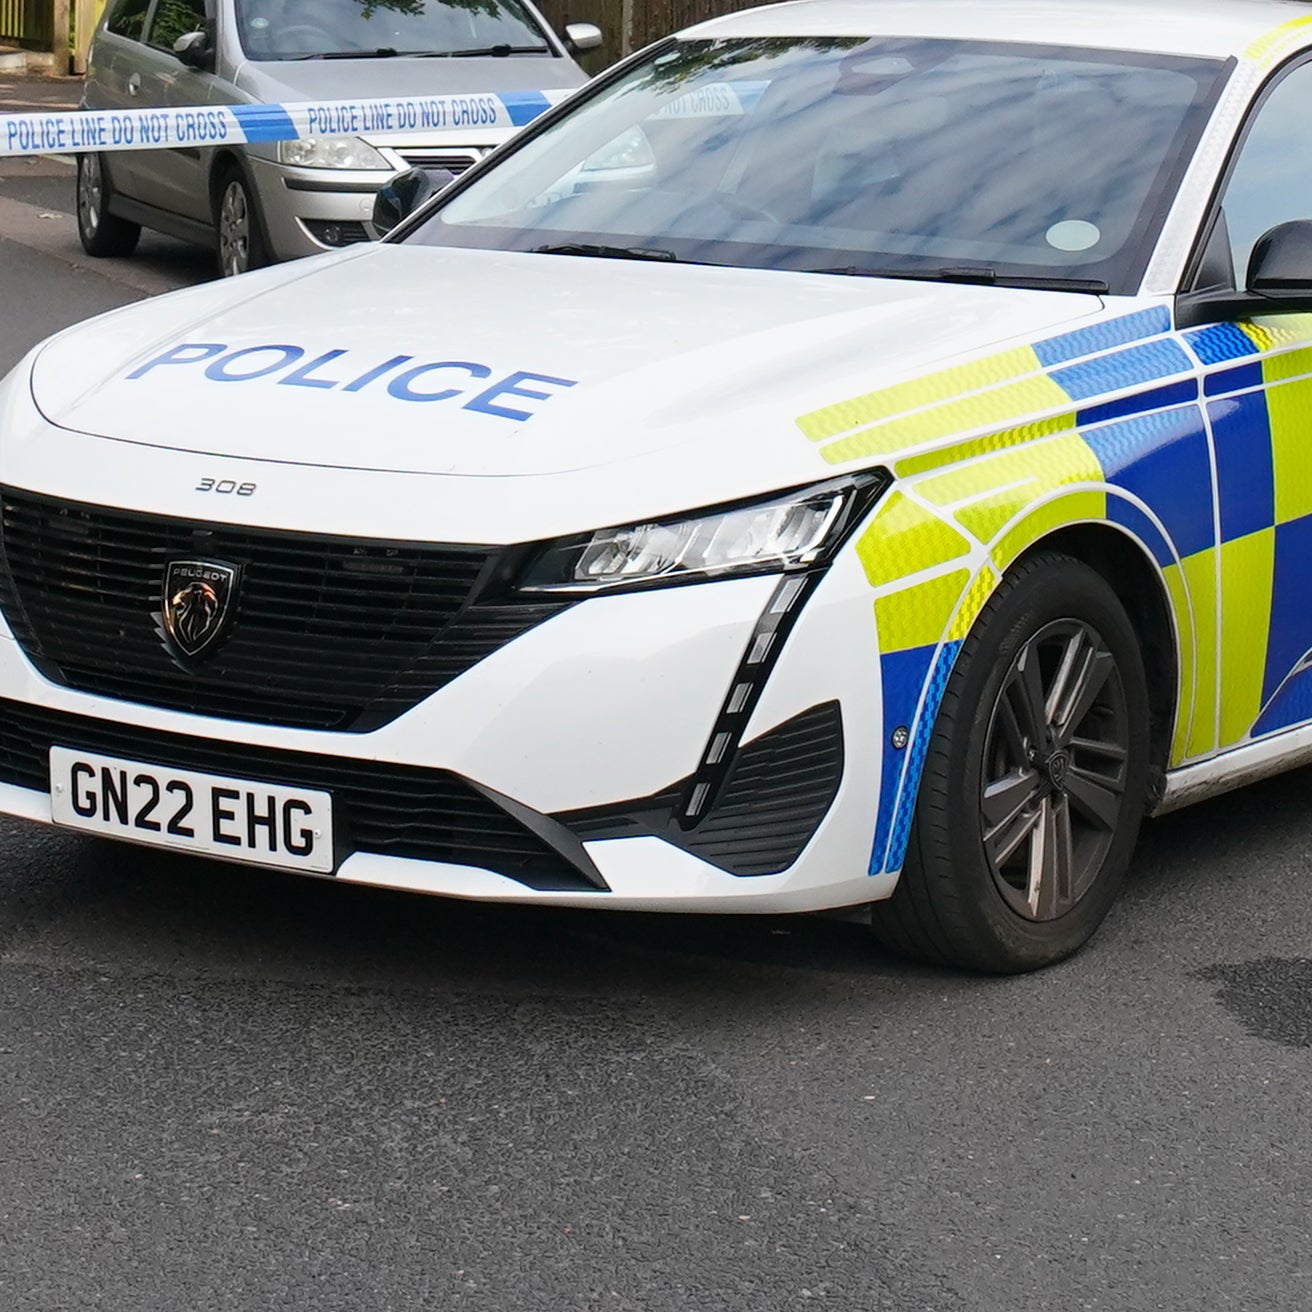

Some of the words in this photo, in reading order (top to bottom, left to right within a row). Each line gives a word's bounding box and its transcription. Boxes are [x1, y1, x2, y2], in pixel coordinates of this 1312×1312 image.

[7, 118, 66, 150] POLICE
[70, 117, 107, 146] LINE
[111, 115, 134, 145] DO
[139, 113, 169, 143] NOT
[176, 111, 227, 141] CROSS
[307, 105, 358, 134] POLICE
[361, 103, 393, 131] LINE
[396, 102, 416, 129] DO
[419, 100, 447, 127] NOT
[451, 97, 497, 126] CROSS
[125, 343, 579, 422] POLICE
[195, 477, 257, 496] 308
[172, 568, 228, 582] PEUGEOT
[71, 761, 195, 838] GN22
[211, 786, 314, 857] EHG
